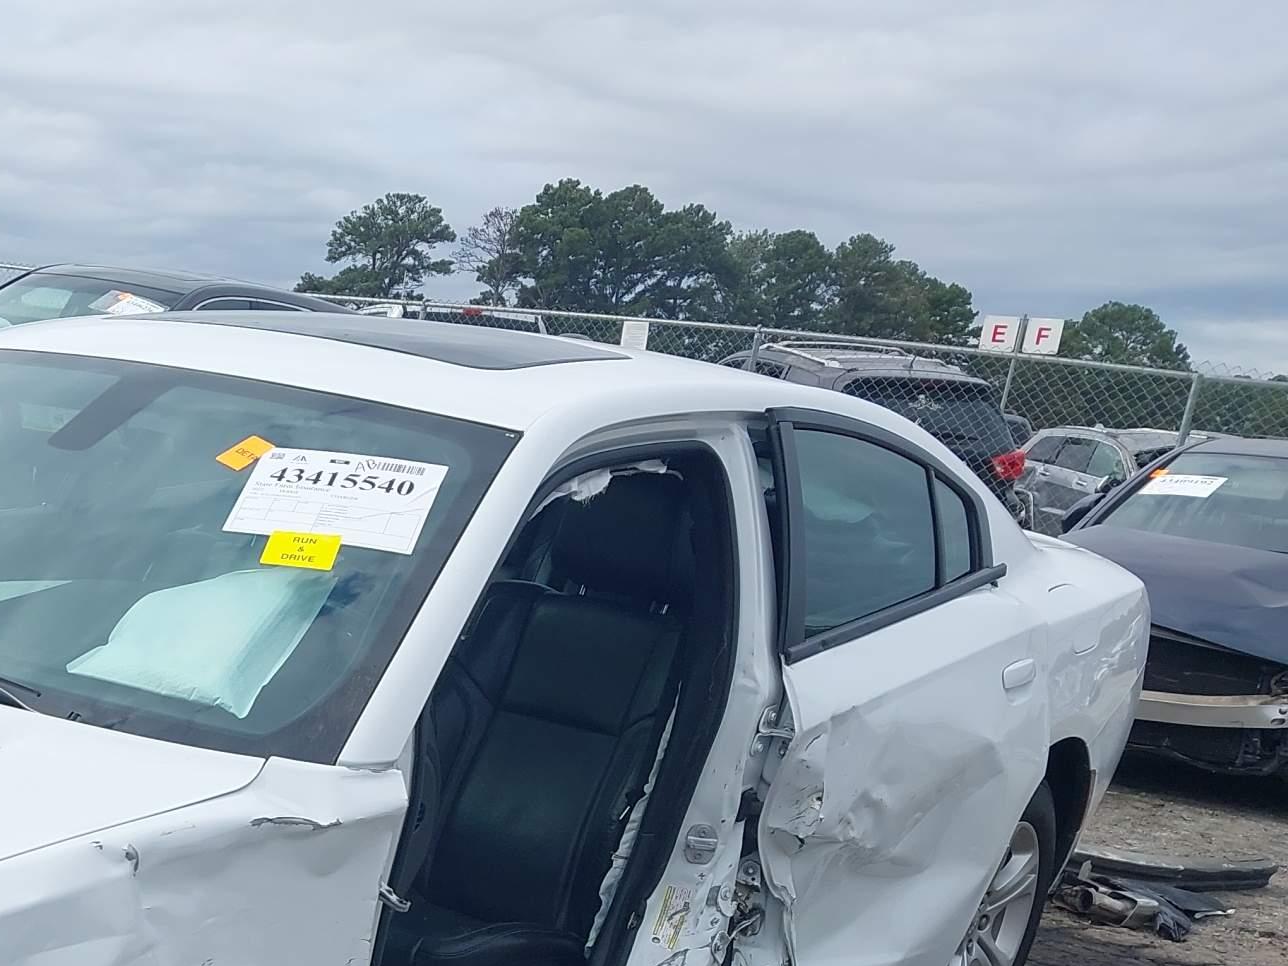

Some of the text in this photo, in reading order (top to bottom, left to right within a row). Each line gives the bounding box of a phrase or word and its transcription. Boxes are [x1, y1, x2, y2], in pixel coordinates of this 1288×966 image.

[991, 324, 1008, 343] E
[1035, 327, 1052, 345] F
[269, 466, 415, 496] 43415540
[292, 536, 317, 545] RUN
[280, 553, 316, 563] DRIVE
